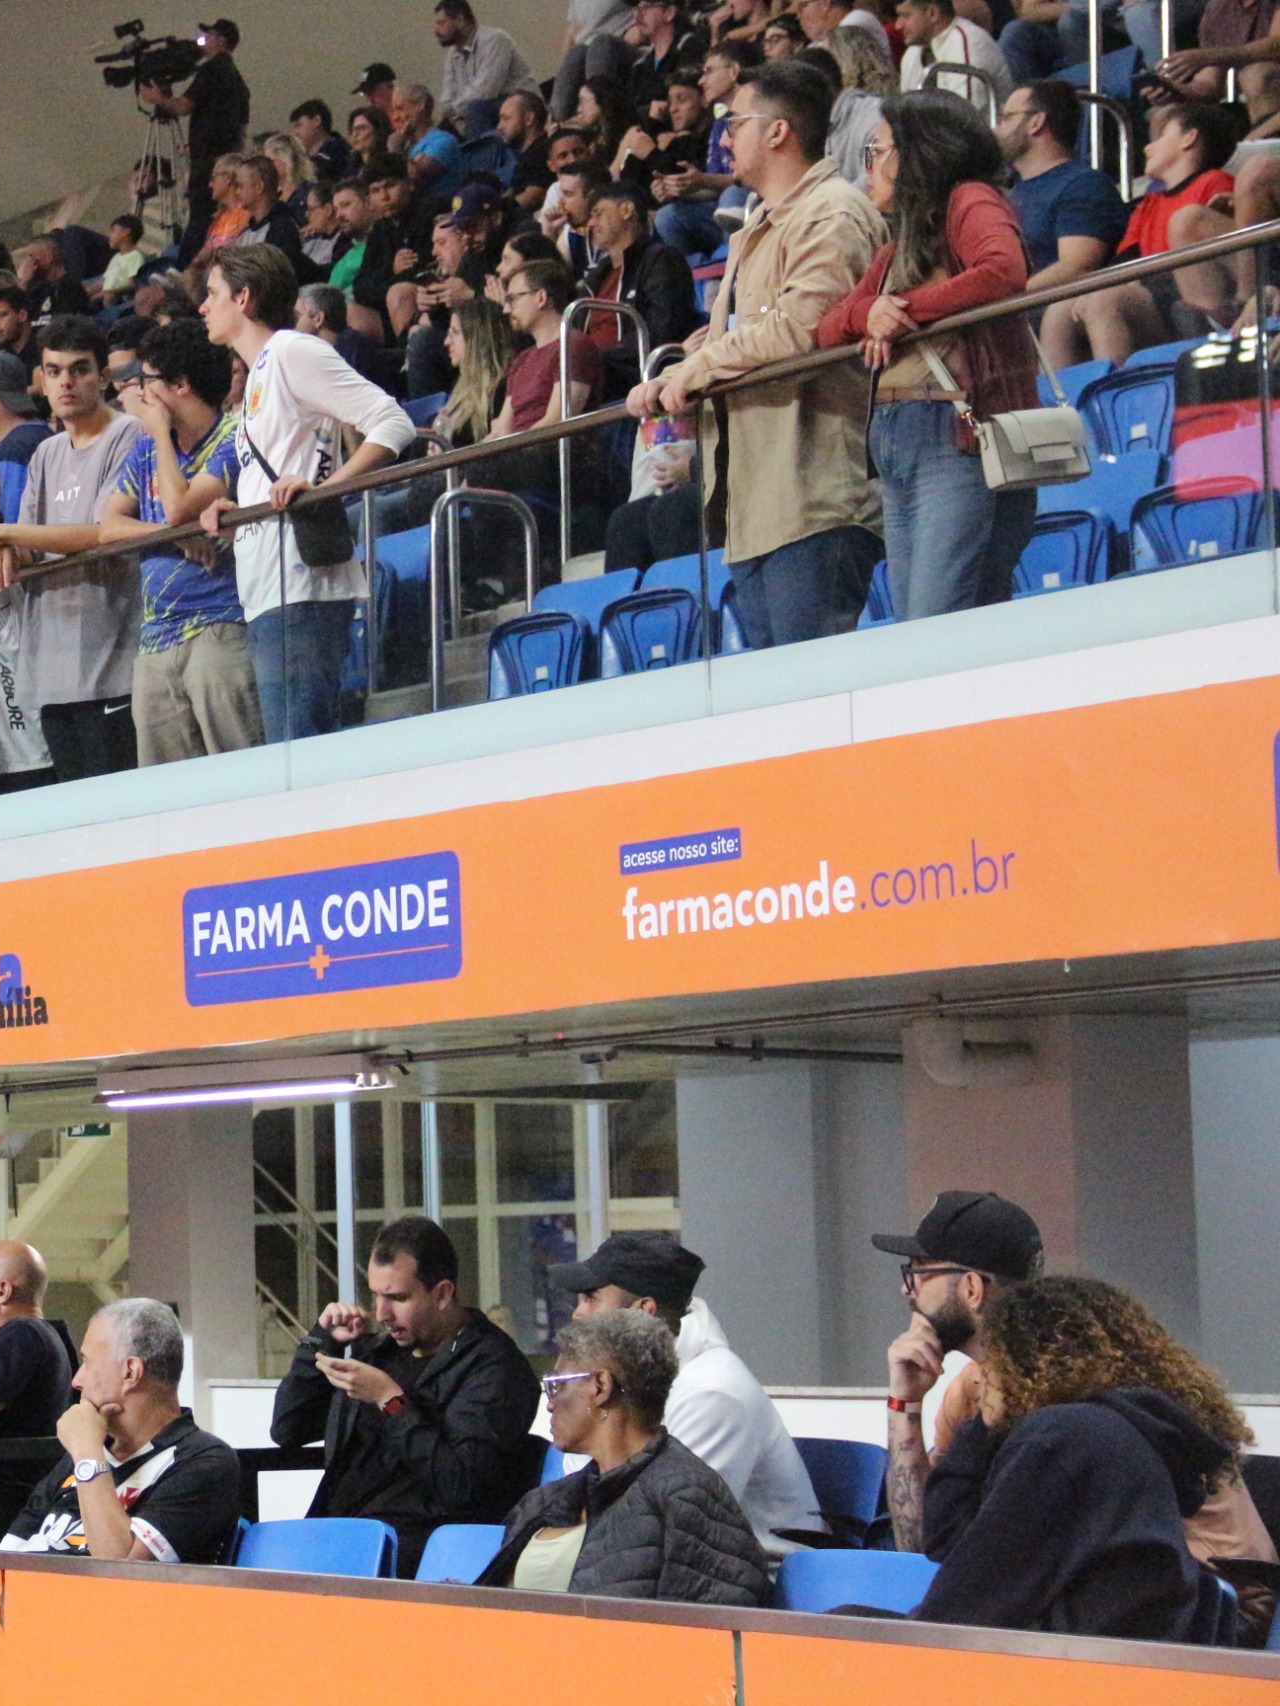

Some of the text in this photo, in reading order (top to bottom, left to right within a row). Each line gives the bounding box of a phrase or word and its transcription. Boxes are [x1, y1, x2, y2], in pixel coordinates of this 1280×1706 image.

[622, 838, 1016, 941] farmaconde.com.br
[623, 834, 739, 868] acesse nosso site:
[192, 878, 450, 957] FARMA CONDE
